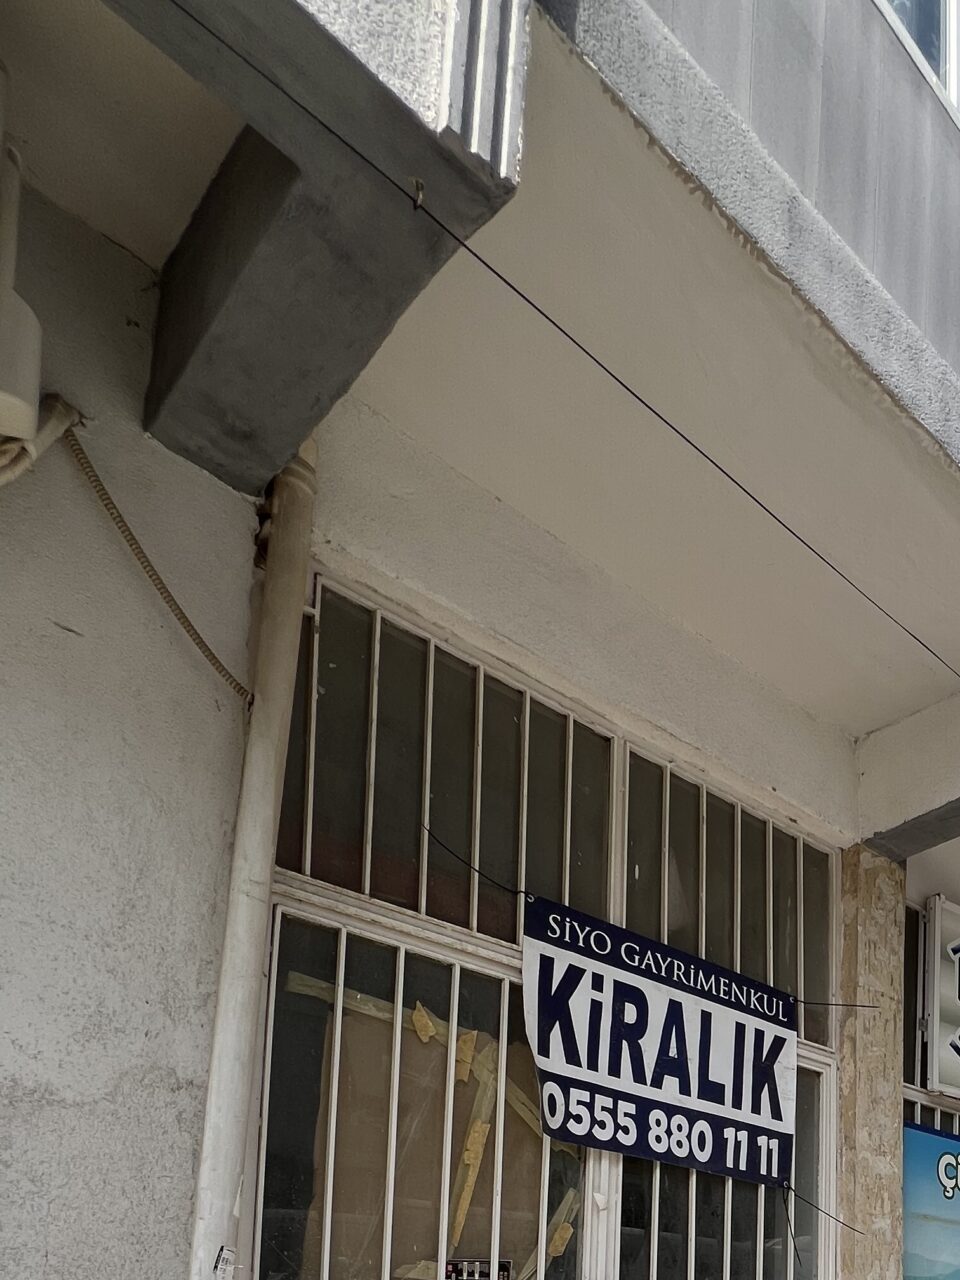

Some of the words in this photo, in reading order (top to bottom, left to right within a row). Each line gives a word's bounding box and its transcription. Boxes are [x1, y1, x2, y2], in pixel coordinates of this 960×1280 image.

[542, 1081, 637, 1147] 0555
[647, 1109, 713, 1163] 880
[723, 1126, 747, 1171] 11
[757, 1135, 779, 1178] 11
